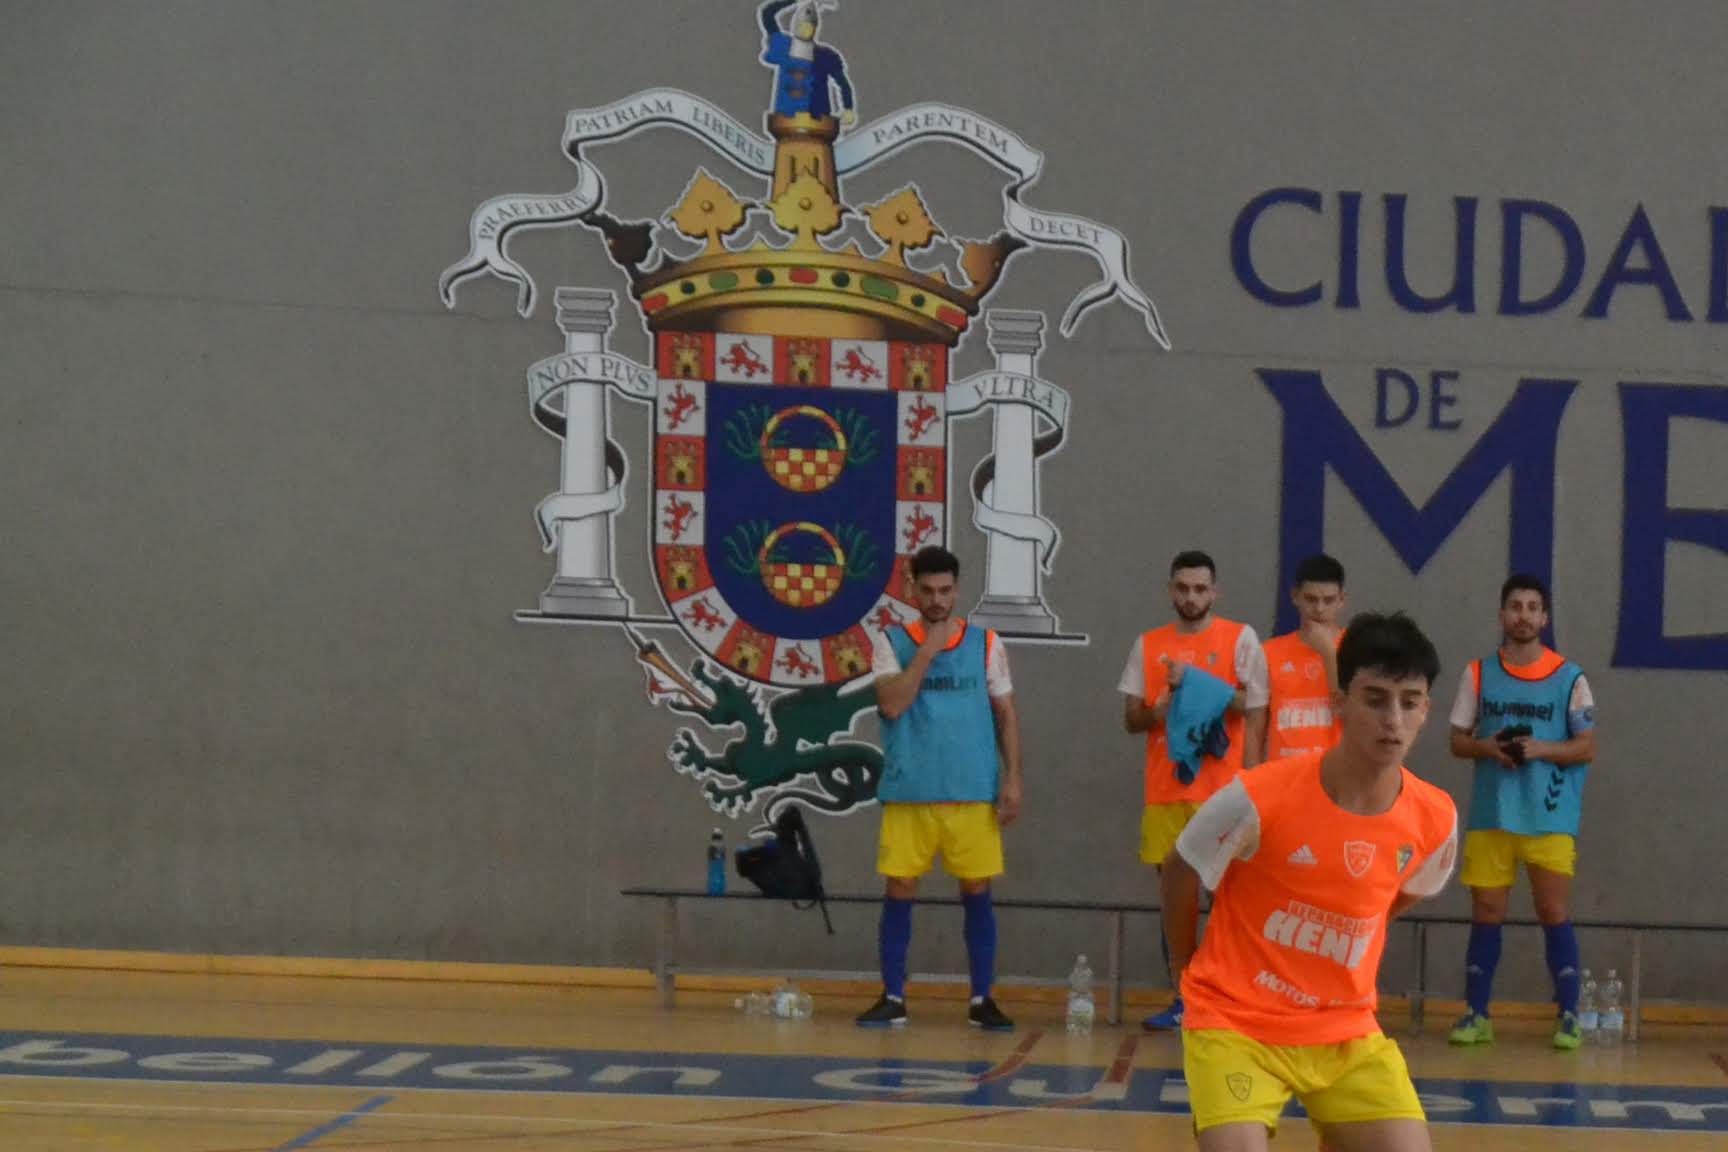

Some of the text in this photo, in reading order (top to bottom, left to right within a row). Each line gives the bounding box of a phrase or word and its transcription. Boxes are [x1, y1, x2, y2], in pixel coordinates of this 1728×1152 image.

[574, 99, 766, 167] PATRIAM LIBERIS
[871, 112, 1009, 155] PARENTEM
[1029, 216, 1106, 245] DECET
[535, 356, 652, 393] NON PLVS
[972, 375, 1055, 409] VLTRA
[1374, 367, 1462, 431] DE
